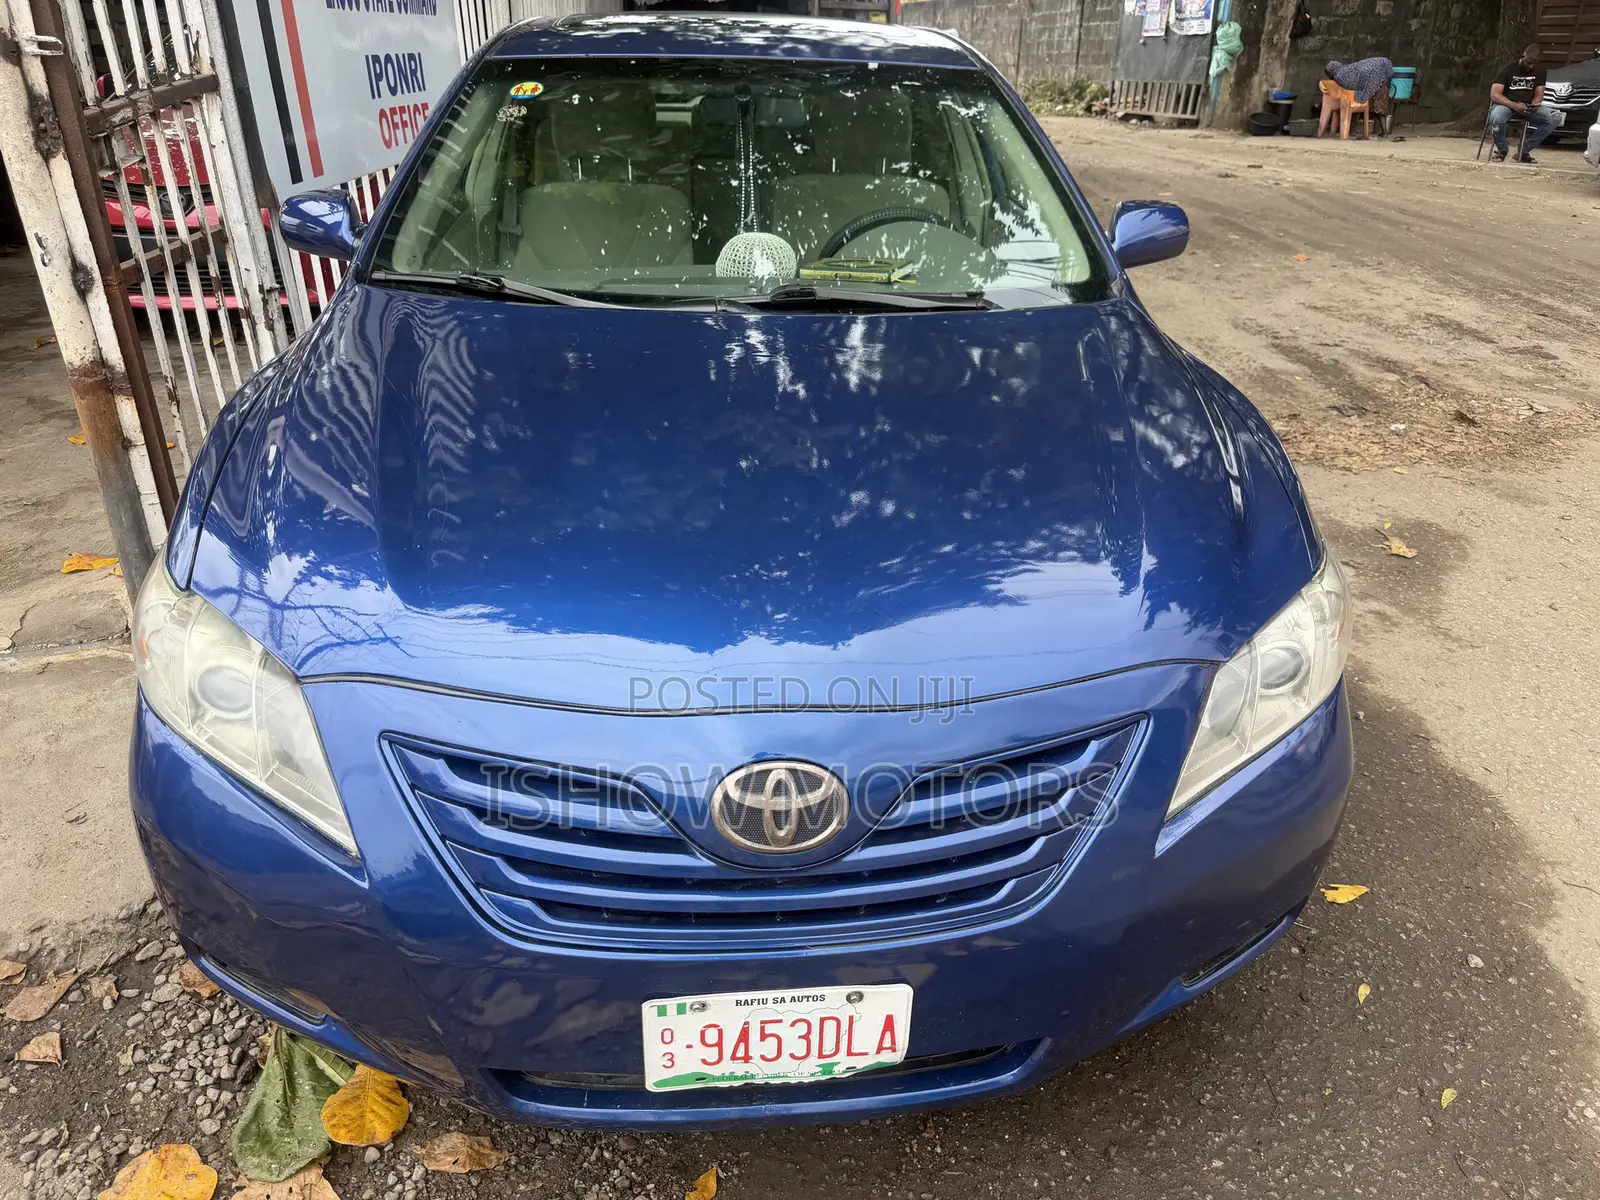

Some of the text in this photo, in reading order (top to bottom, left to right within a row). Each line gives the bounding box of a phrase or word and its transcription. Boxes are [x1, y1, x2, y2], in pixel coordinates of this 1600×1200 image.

[364, 52, 426, 99] IPONRI
[735, 994, 826, 1007] RAFIU SA AUTOS
